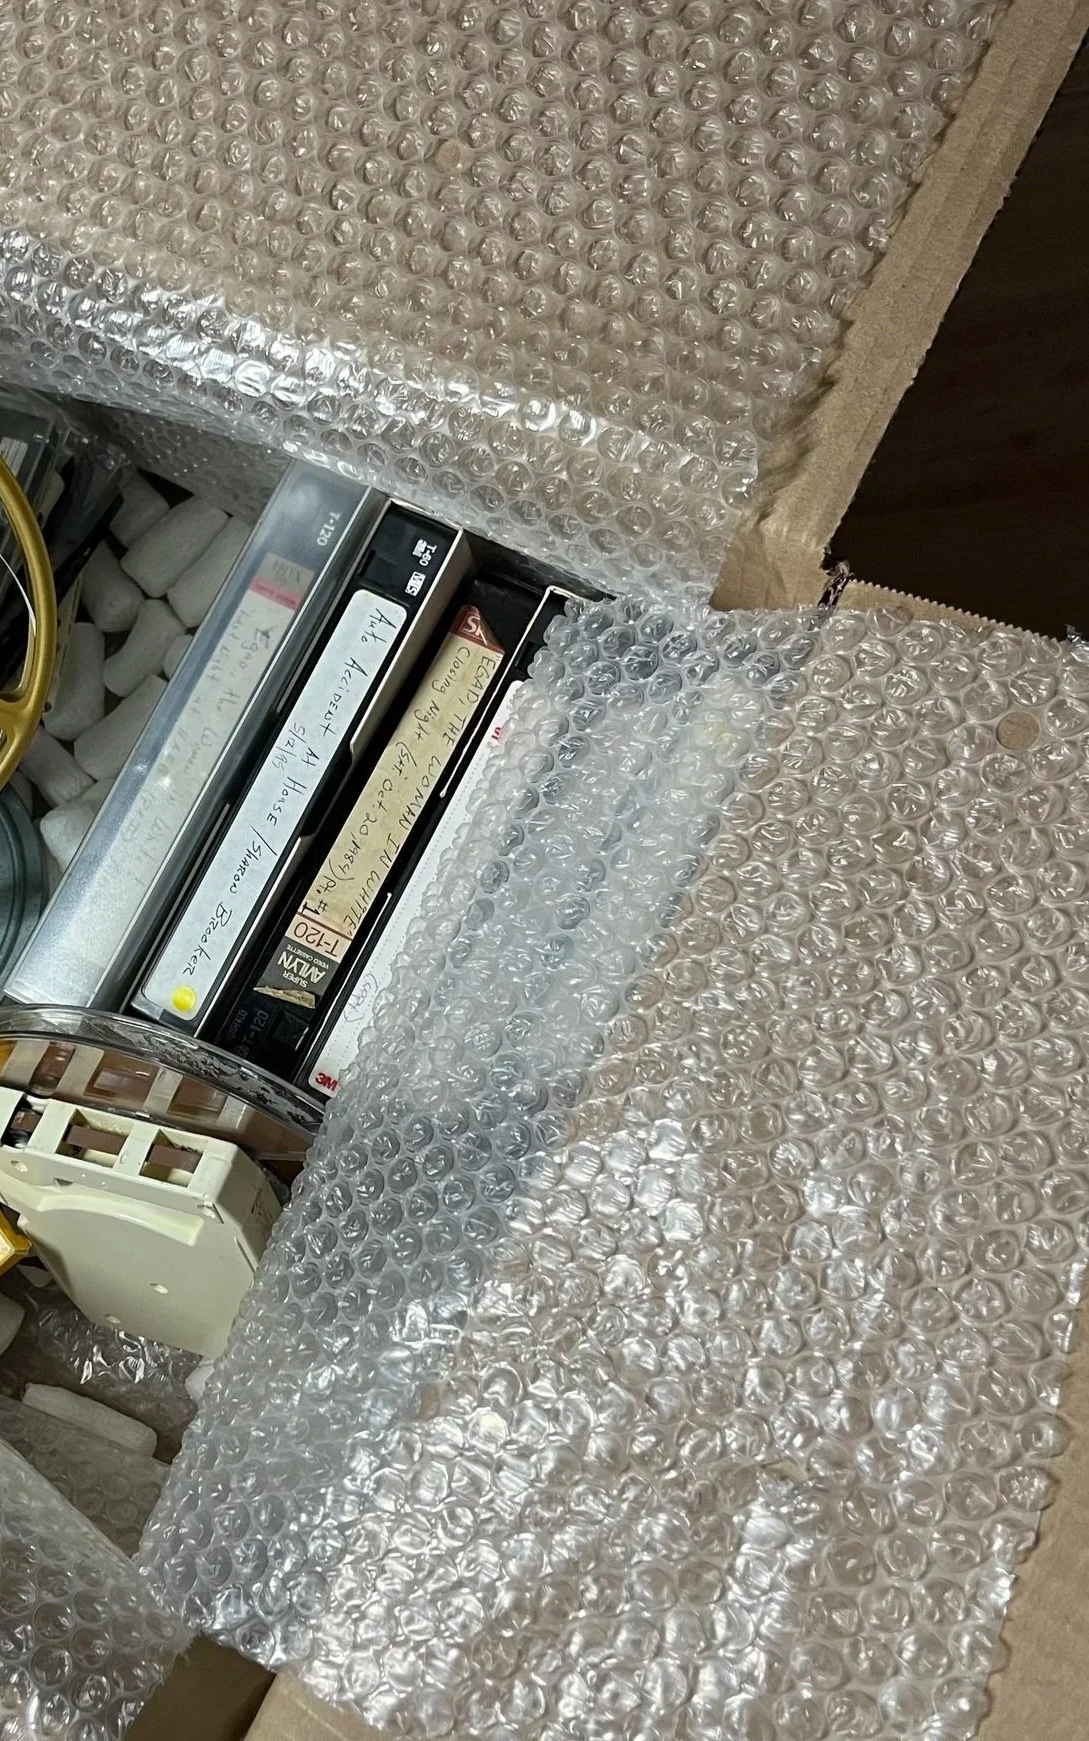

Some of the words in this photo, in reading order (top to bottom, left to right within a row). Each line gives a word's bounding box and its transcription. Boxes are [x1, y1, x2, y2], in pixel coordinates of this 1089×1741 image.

[316, 511, 341, 546] T-120
[360, 607, 397, 643] Auto
[431, 646, 471, 695] Closing
[413, 699, 441, 741] Night
[442, 713, 467, 747] THE
[398, 755, 442, 831] WOMAN
[379, 832, 400, 869] IN
[293, 921, 340, 958] T-120
[277, 951, 326, 984] AVILYN
[282, 970, 309, 989] SUPER
[315, 1071, 340, 1092] 3M
